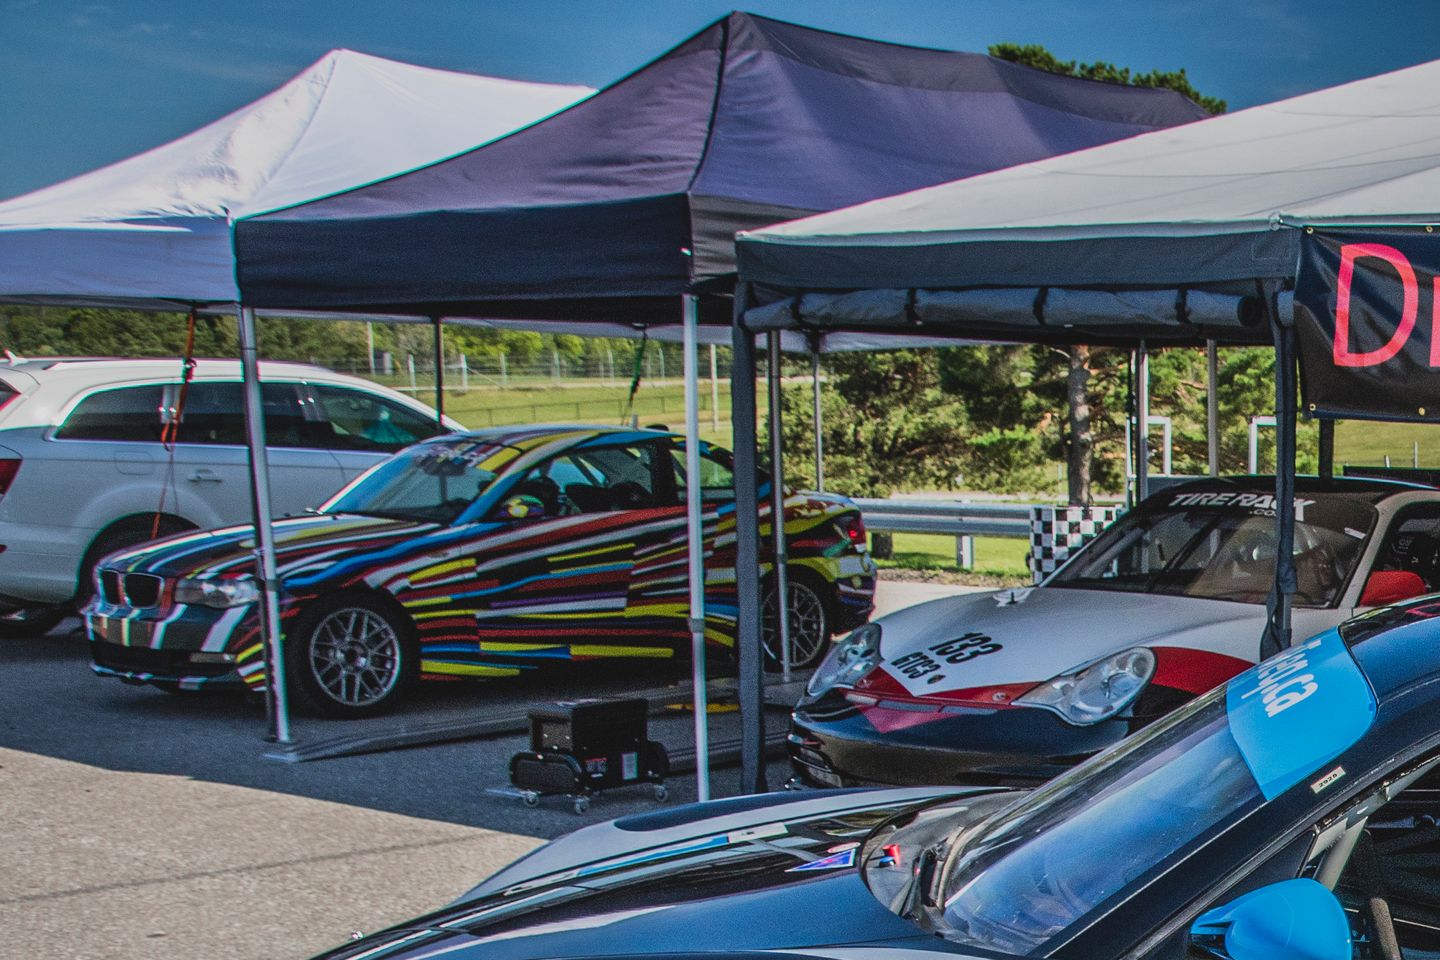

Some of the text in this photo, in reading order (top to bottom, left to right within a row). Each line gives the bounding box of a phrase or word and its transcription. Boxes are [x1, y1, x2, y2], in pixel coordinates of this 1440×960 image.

[1168, 493, 1316, 521] TIRE RAK
[1250, 510, 1277, 518] .co
[928, 632, 1003, 664] 133
